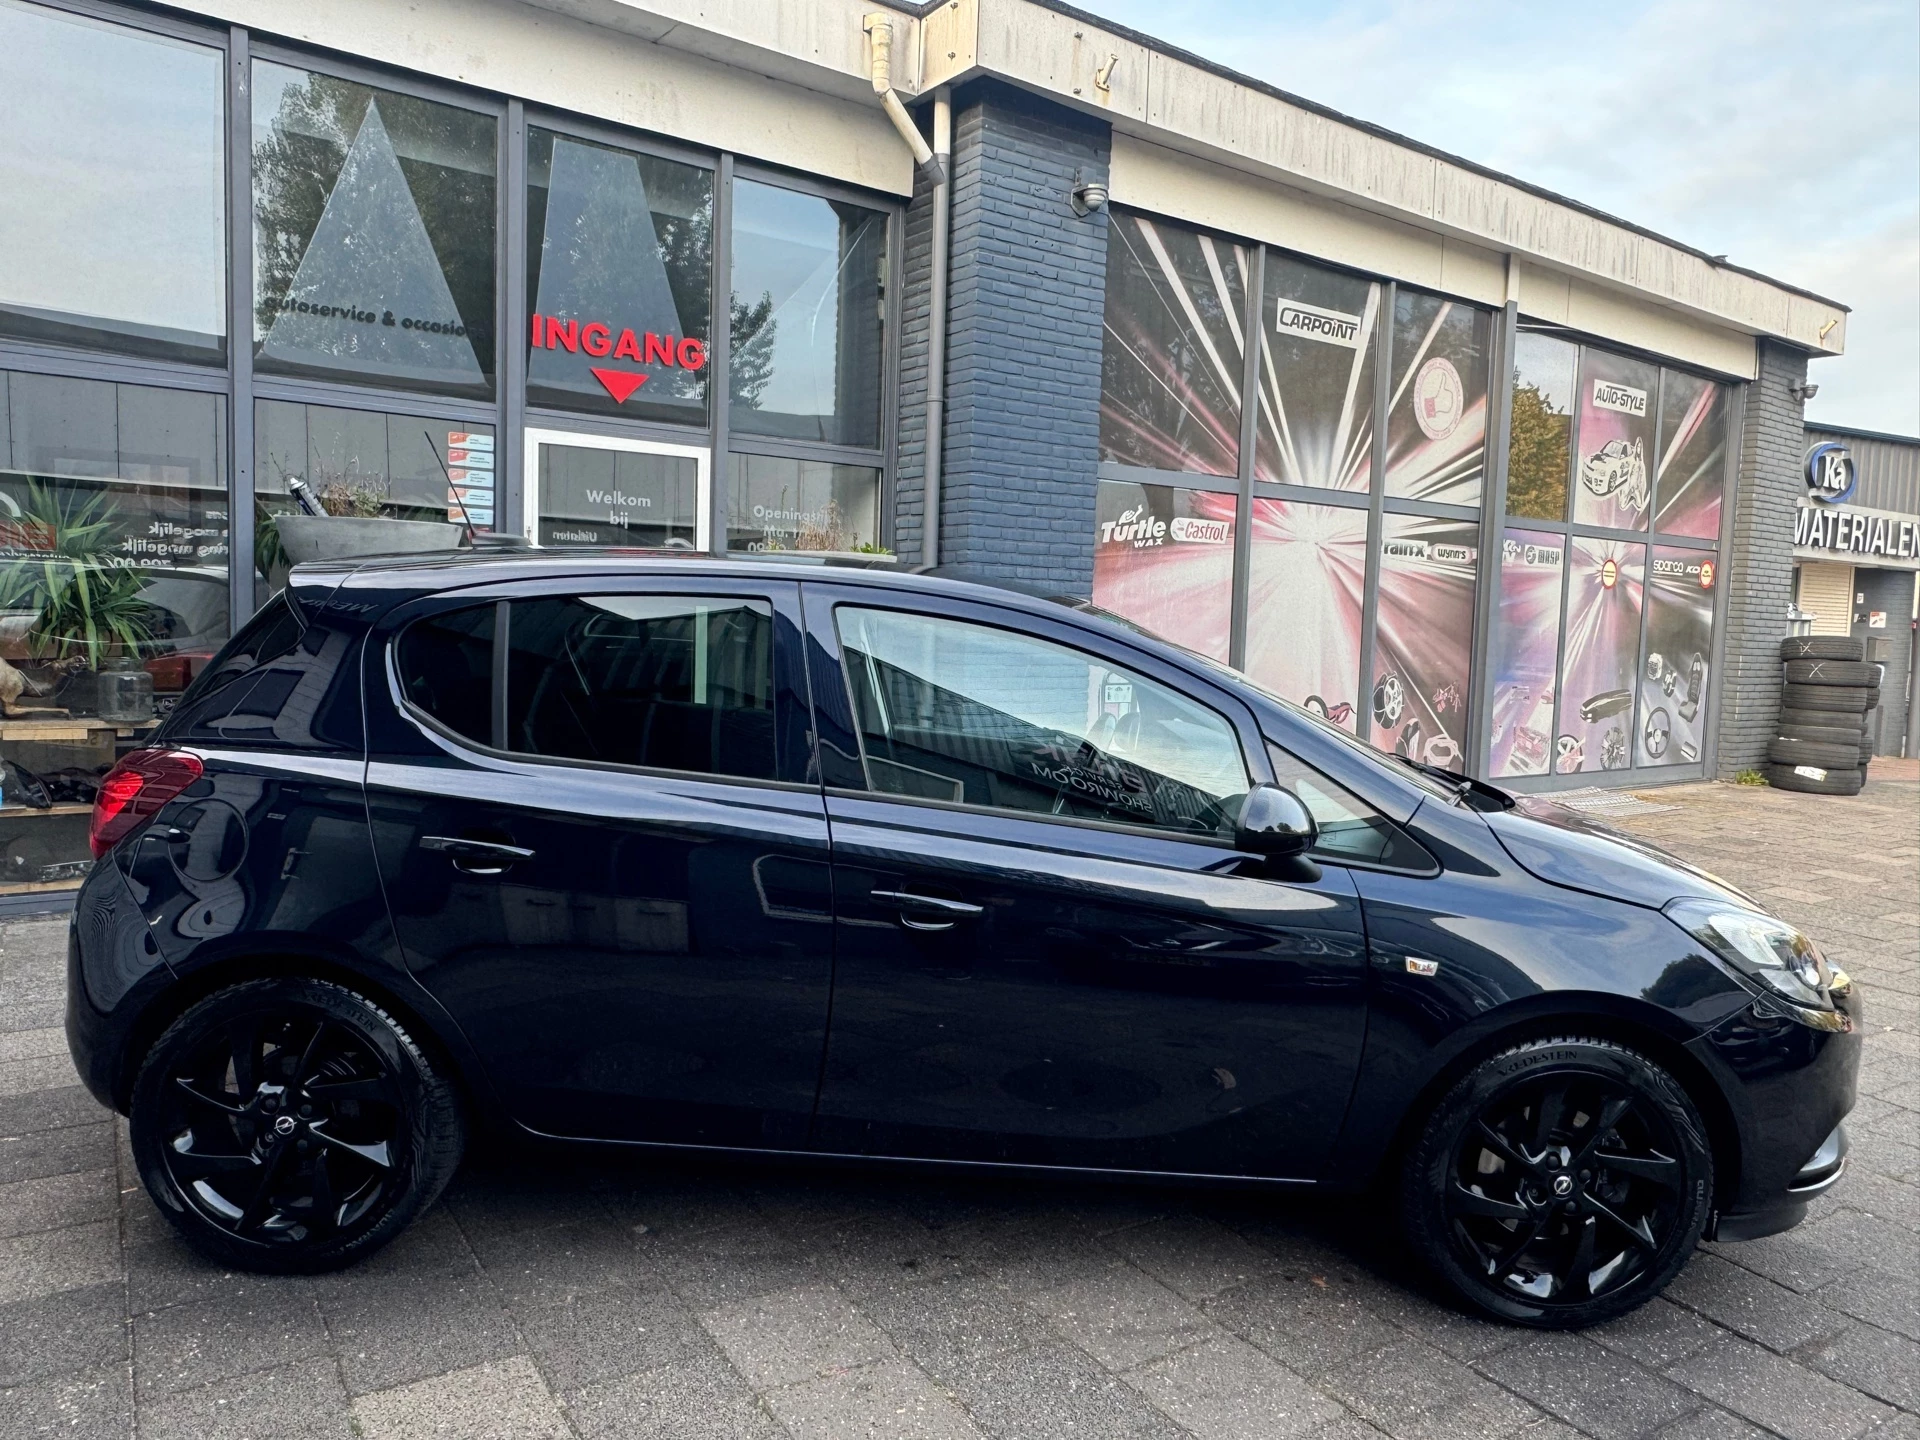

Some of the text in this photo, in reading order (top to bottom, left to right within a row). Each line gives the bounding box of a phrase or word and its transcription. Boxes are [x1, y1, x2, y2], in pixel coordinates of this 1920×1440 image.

[381, 310, 396, 327] &
[532, 313, 705, 371] INGANG
[586, 489, 651, 507] Welkom
[609, 510, 628, 530] bij
[1101, 516, 1167, 543] Turtle
[1185, 521, 1225, 541] Castrol
[1134, 538, 1164, 549] WAX
